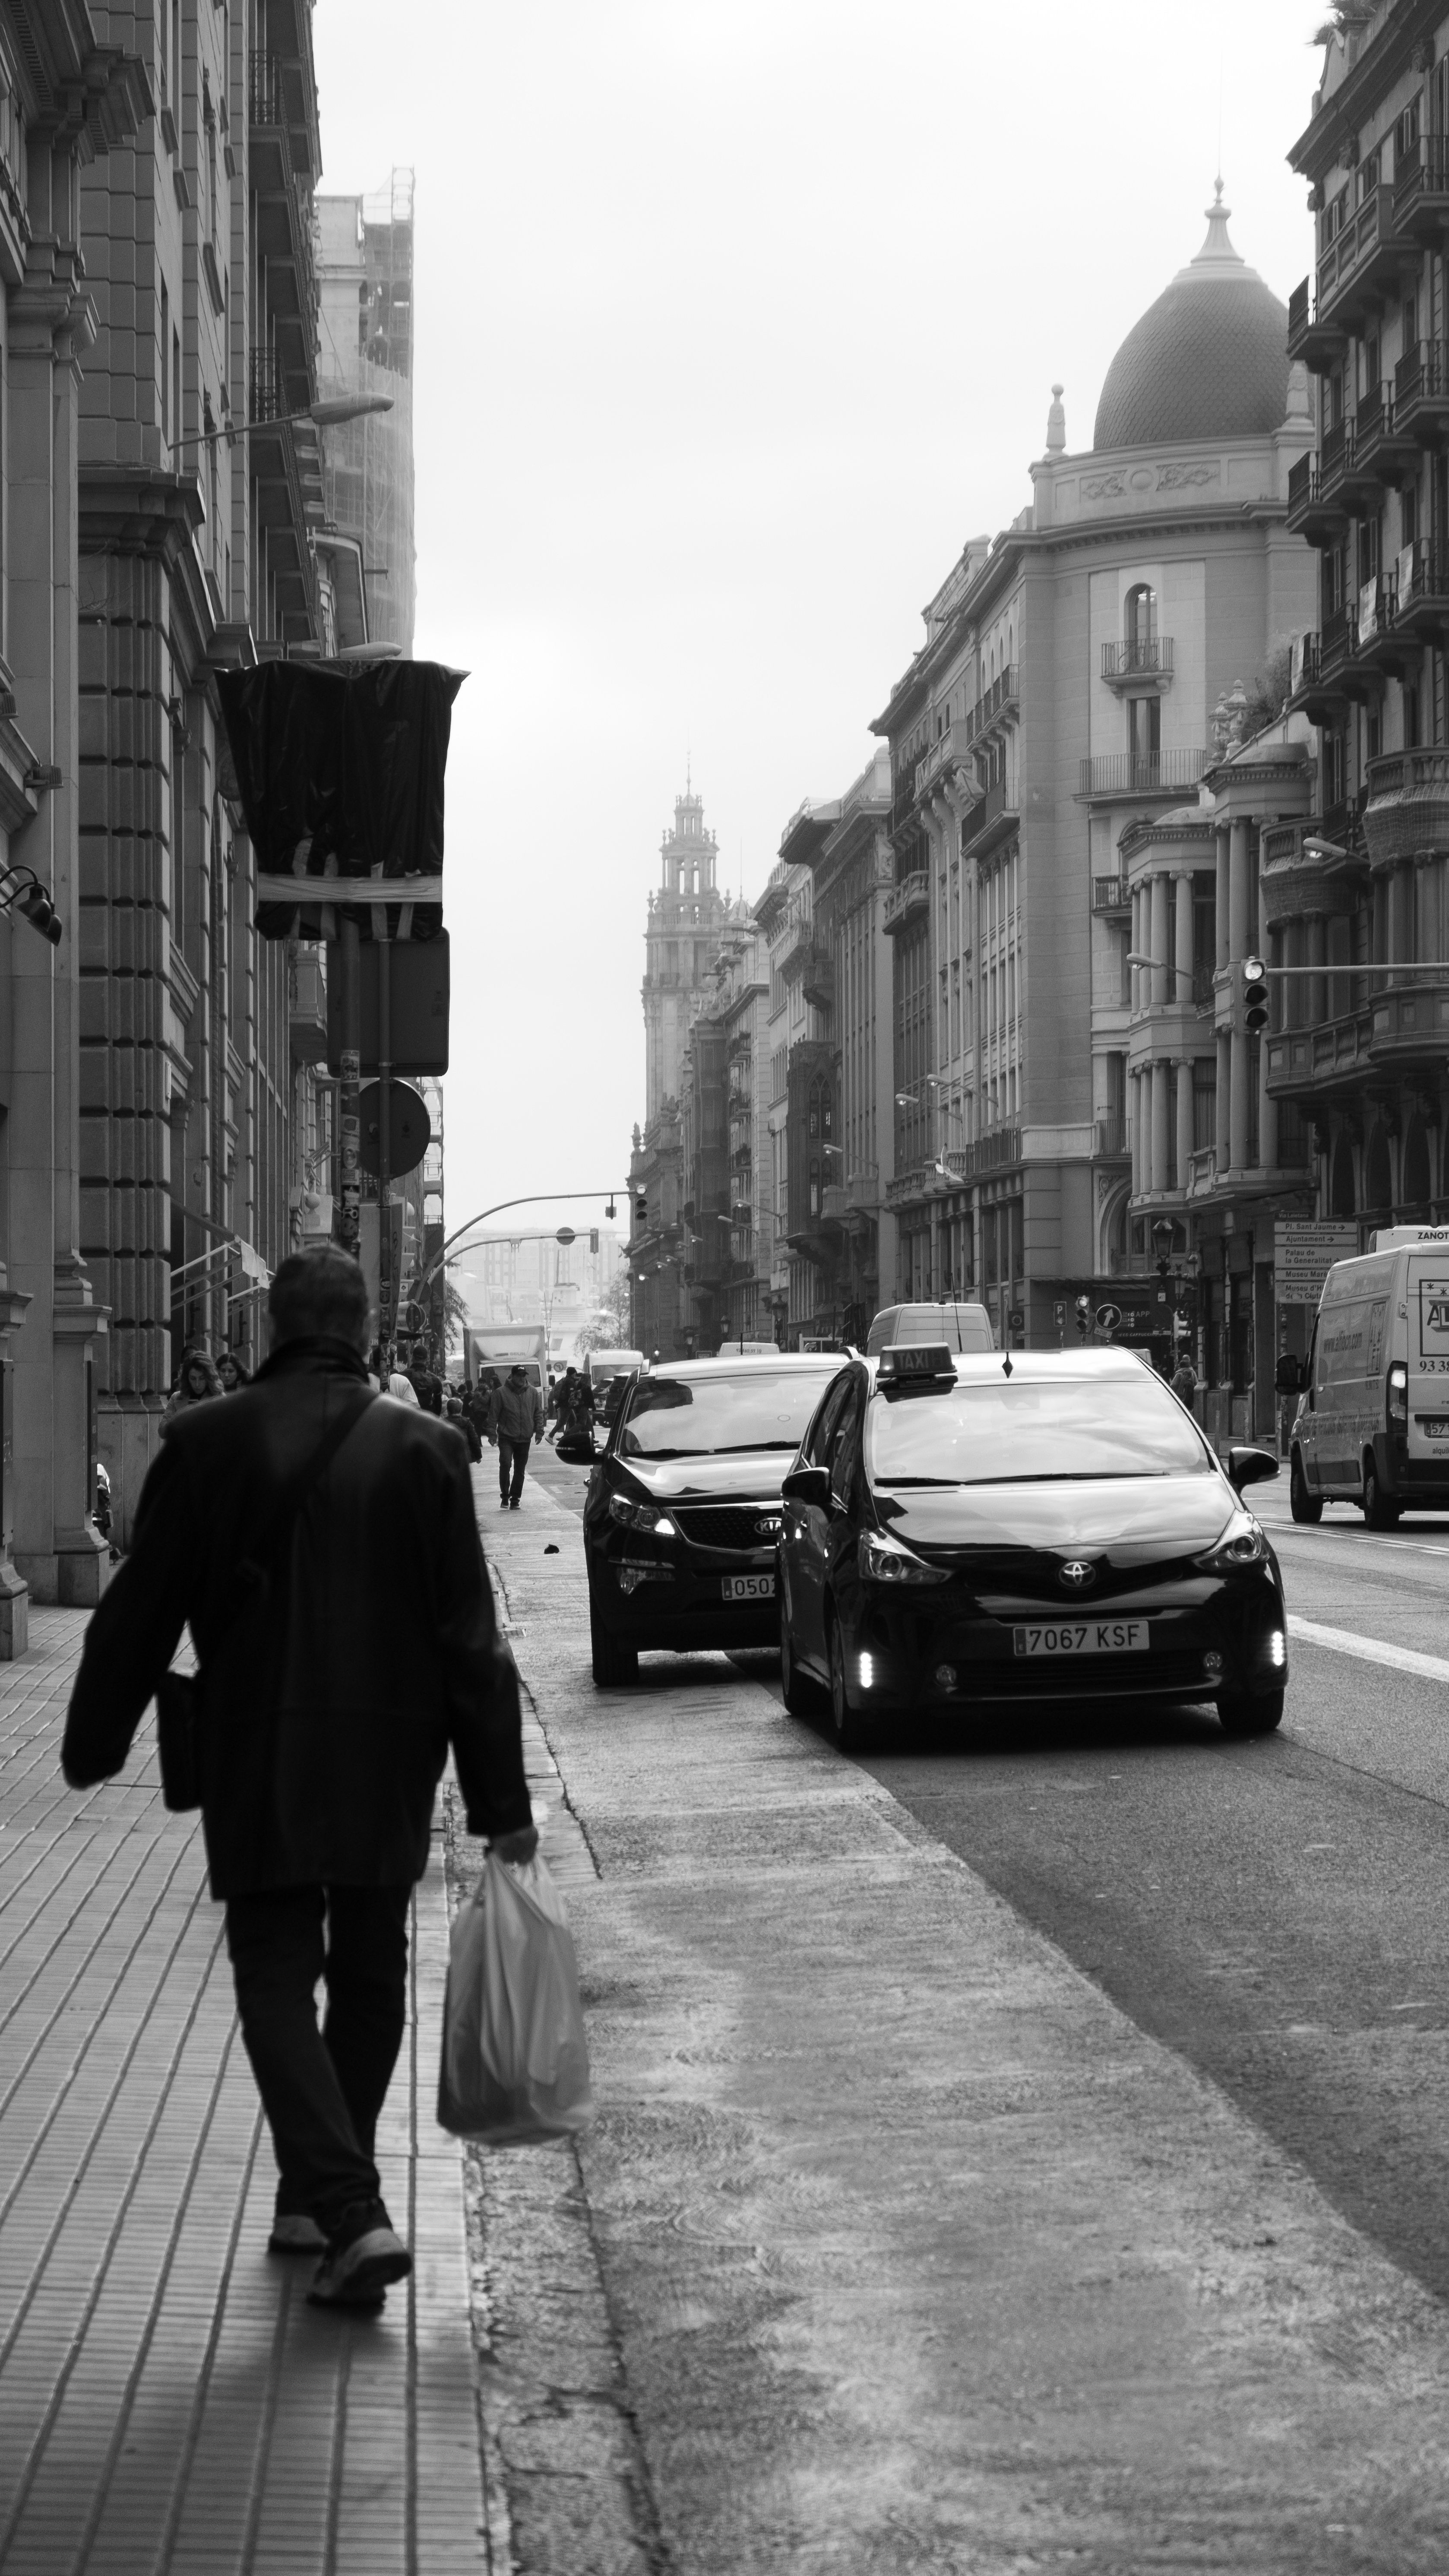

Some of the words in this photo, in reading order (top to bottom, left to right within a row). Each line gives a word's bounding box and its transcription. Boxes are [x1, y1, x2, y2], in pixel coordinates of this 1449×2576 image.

[1057, 1305, 1063, 1314] P
[897, 1351, 929, 1370] TAXI
[1419, 1360, 1435, 1372] 93
[759, 1521, 781, 1532] KIA
[1029, 1627, 1088, 1652] 7067
[1096, 1624, 1140, 1648] KSF
